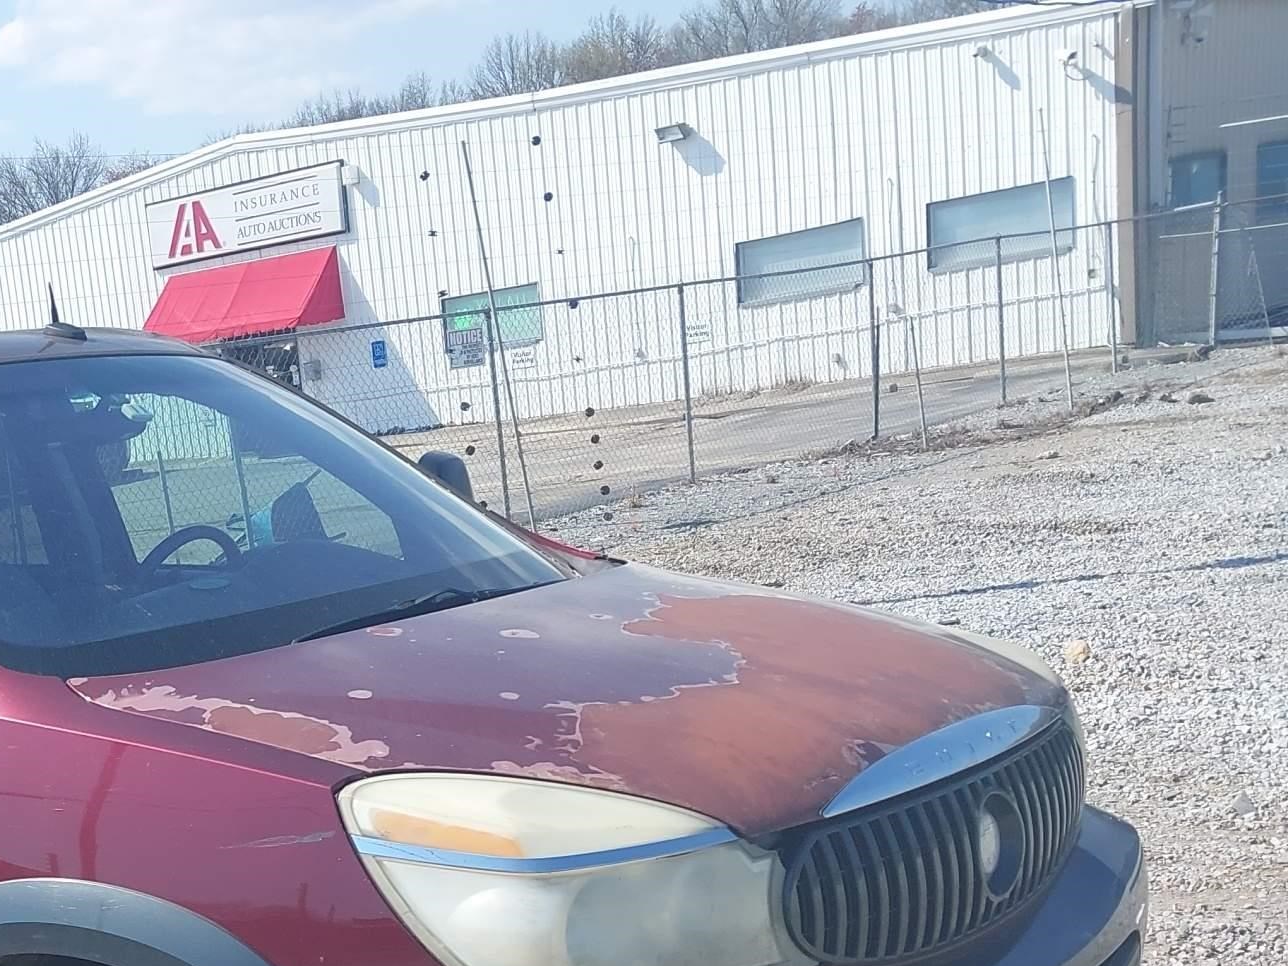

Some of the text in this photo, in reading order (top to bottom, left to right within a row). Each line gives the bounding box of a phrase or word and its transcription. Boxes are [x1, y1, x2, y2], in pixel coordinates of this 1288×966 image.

[233, 184, 320, 213] INSURANCE
[237, 211, 321, 239] AUTO AUCTIONS
[448, 328, 482, 347] NOTICE
